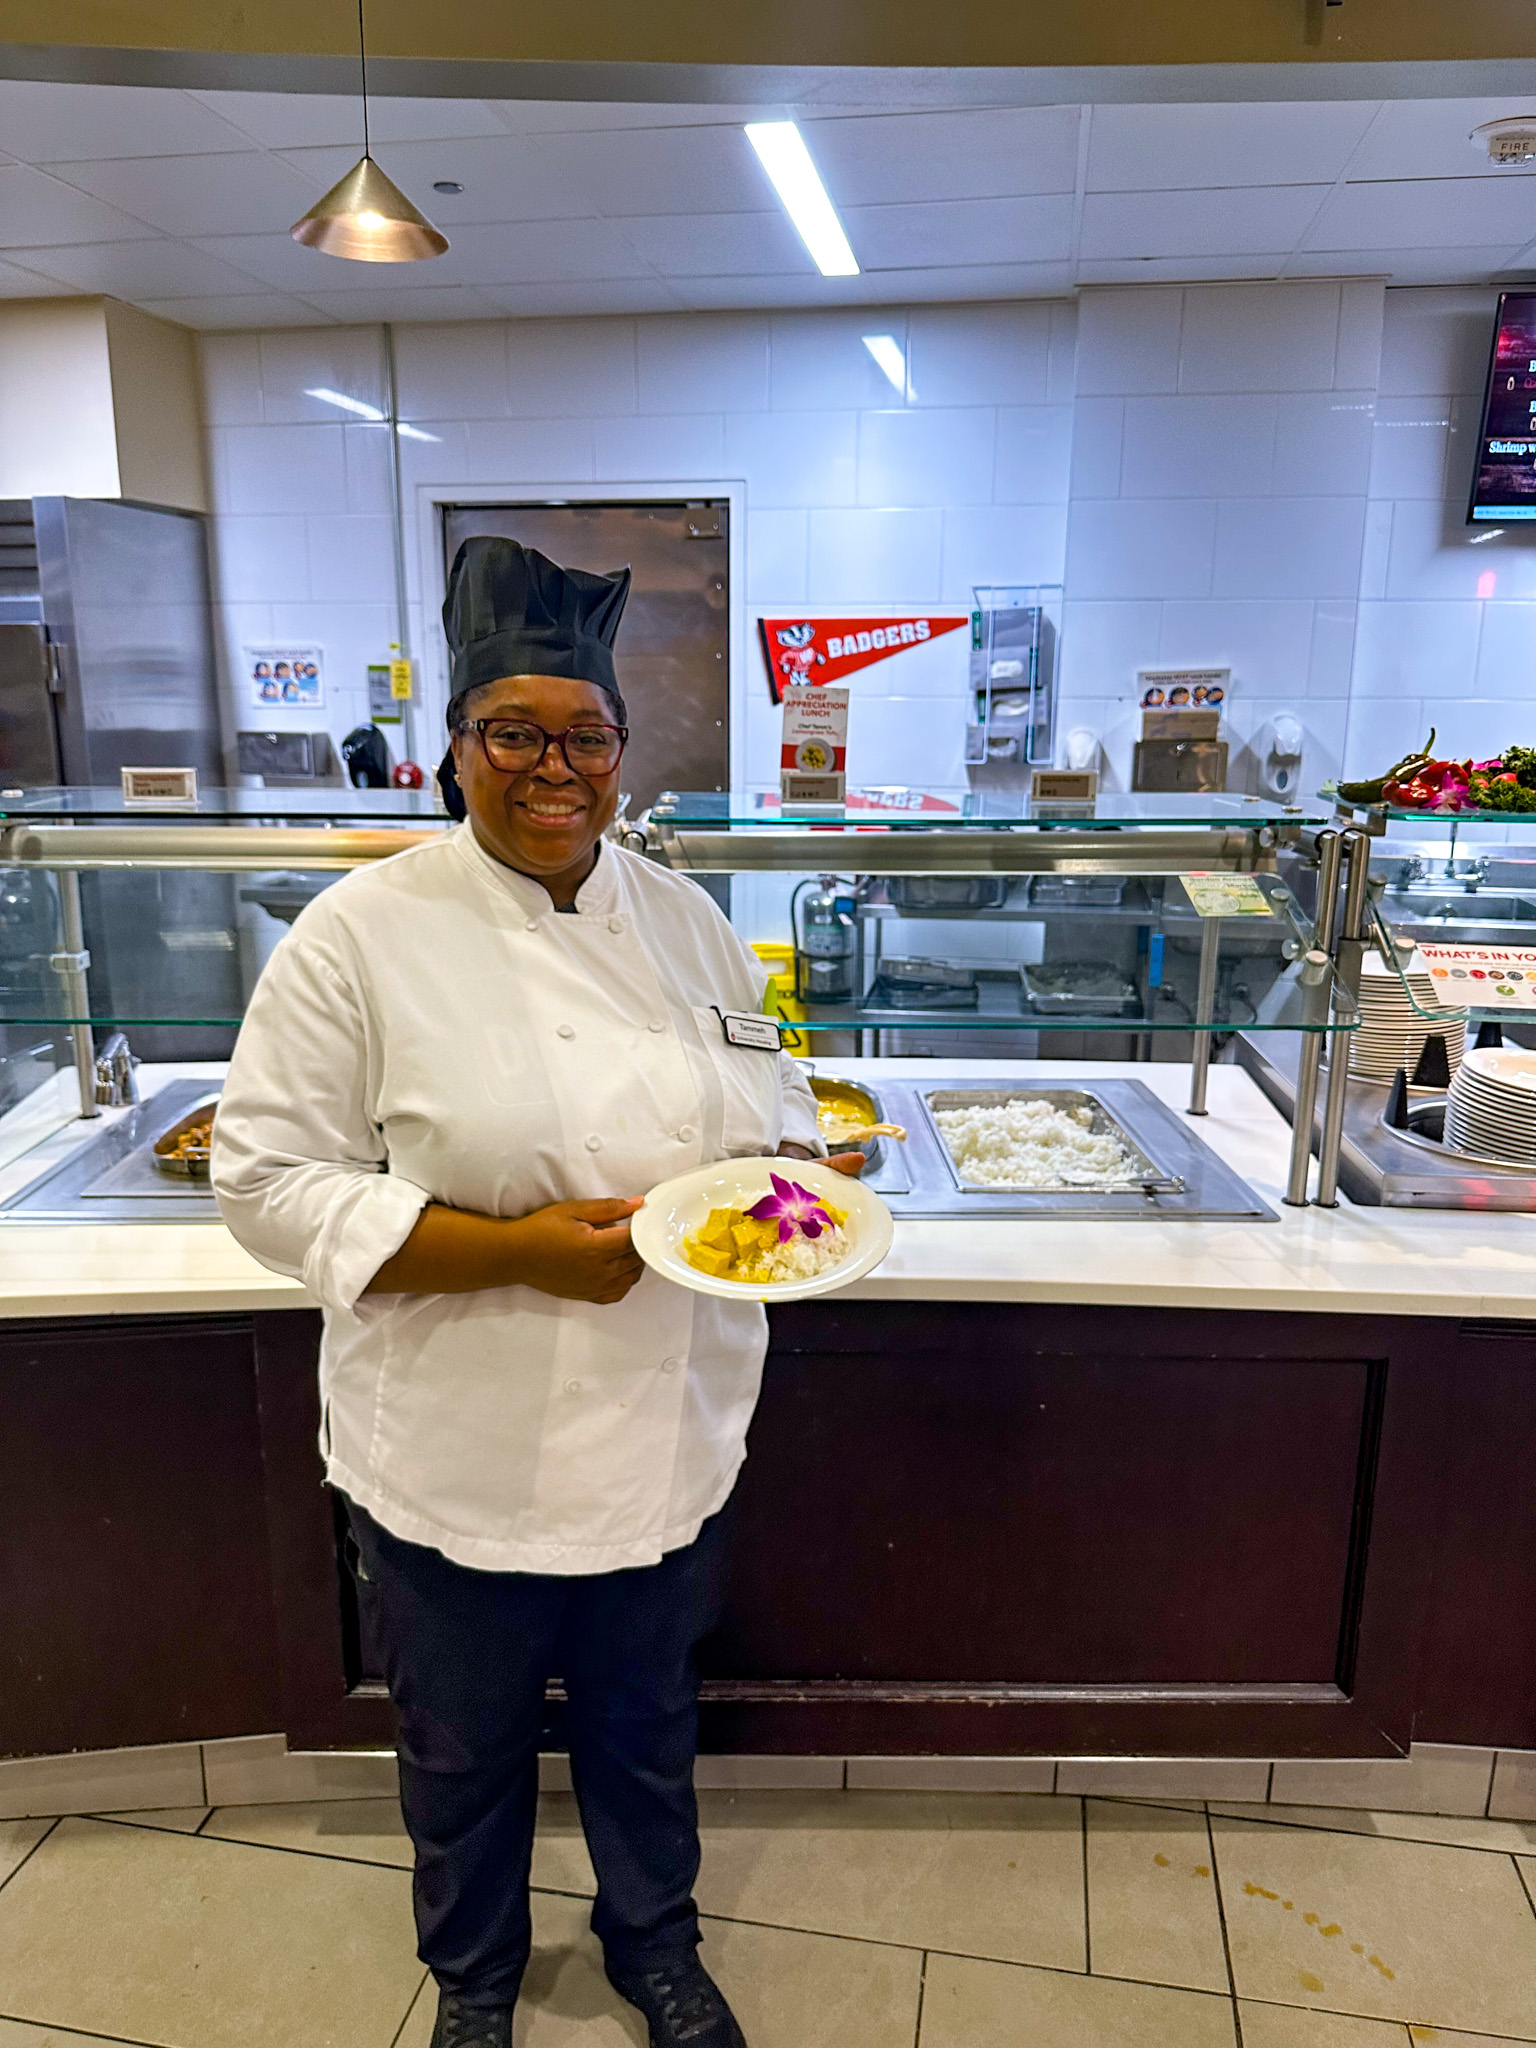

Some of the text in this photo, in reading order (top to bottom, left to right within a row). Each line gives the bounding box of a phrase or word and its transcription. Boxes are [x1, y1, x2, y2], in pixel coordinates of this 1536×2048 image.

[1501, 142, 1530, 151] FIRE
[1488, 441, 1528, 456] Shrimp
[826, 619, 931, 659] BADGERS
[805, 692, 828, 701] CHEF
[786, 700, 847, 711] APPRECIATION
[801, 709, 831, 718] LUNCH
[1421, 949, 1489, 960] WHAT'S
[1491, 952, 1510, 961] IN
[739, 1023, 767, 1034] Tammeh
